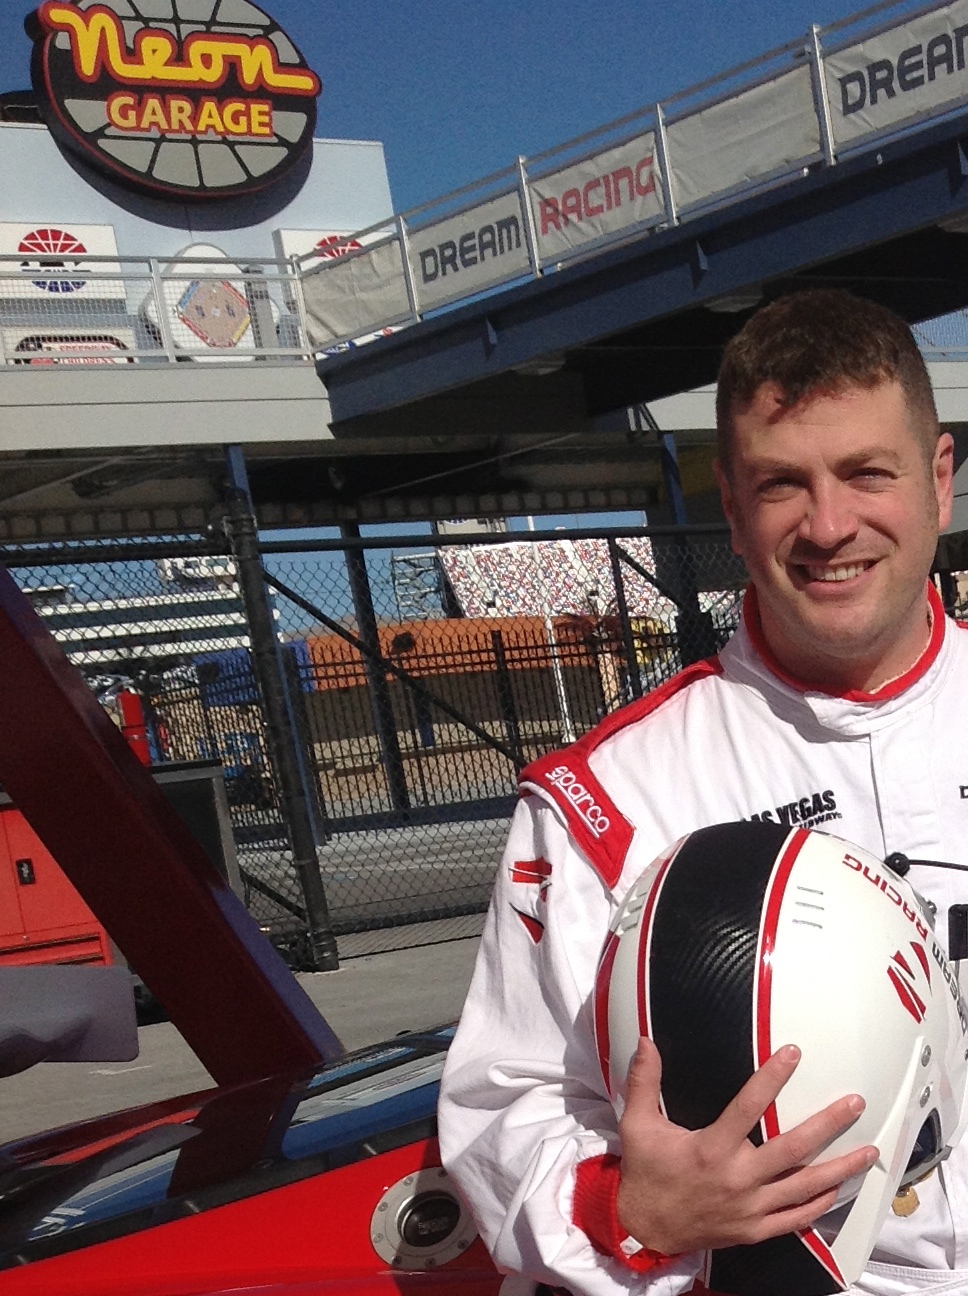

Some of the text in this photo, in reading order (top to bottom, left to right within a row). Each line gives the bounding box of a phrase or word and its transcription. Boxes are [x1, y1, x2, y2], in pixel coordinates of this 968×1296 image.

[108, 95, 271, 135] GARAGE
[419, 155, 657, 284] DREAM RACING
[545, 766, 610, 838] sparco
[776, 790, 836, 825] VEGAS
[842, 853, 929, 942] RACING
